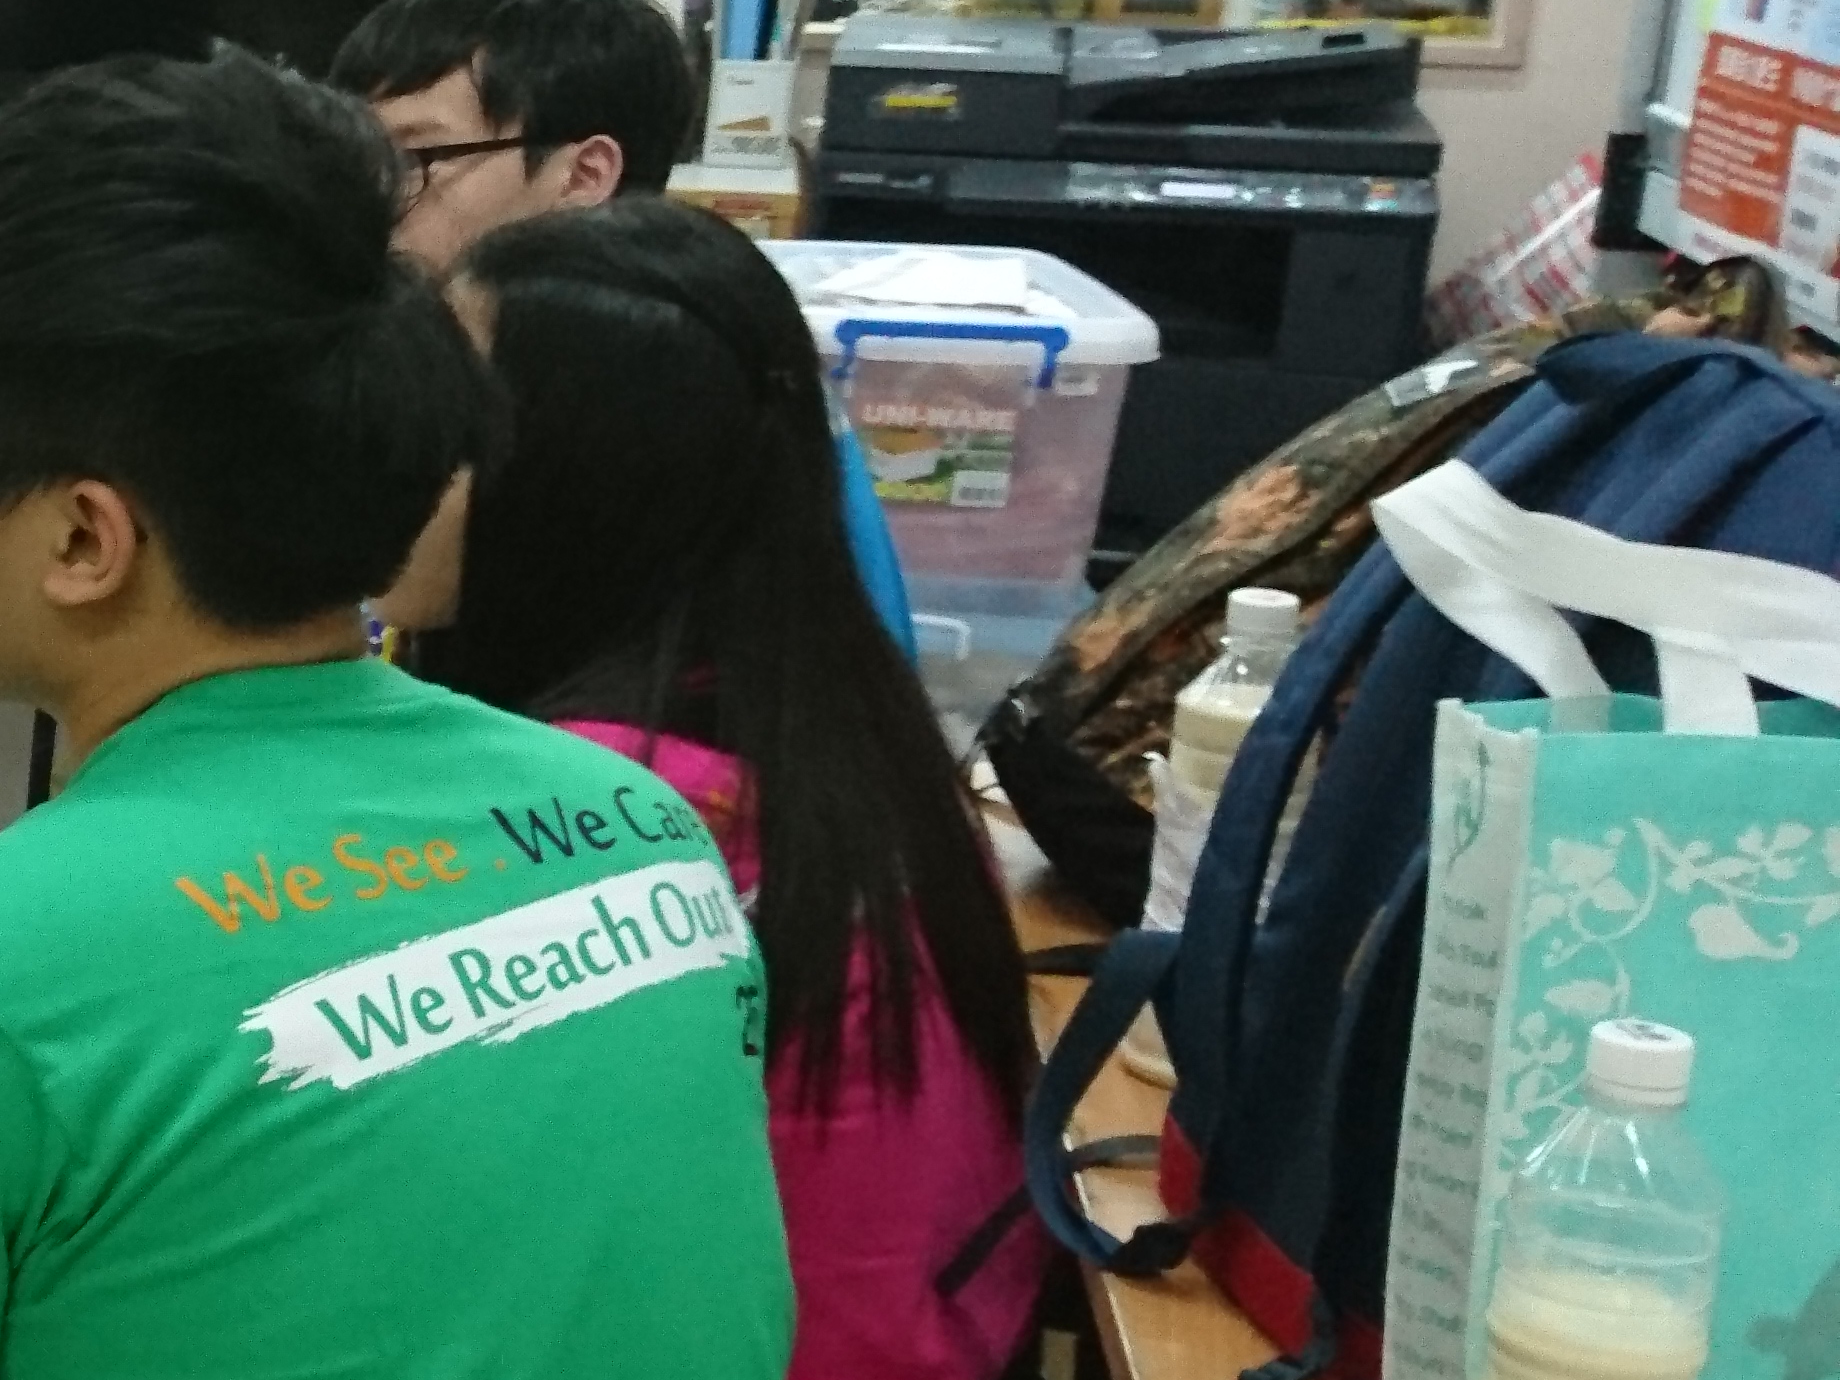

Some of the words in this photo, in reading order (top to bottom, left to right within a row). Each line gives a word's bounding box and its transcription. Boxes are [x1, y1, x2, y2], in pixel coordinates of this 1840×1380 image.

[175, 854, 334, 934] We
[489, 797, 618, 863] We
[314, 974, 454, 1061] We
[448, 895, 651, 1019] Reach
[650, 881, 734, 948] Out
